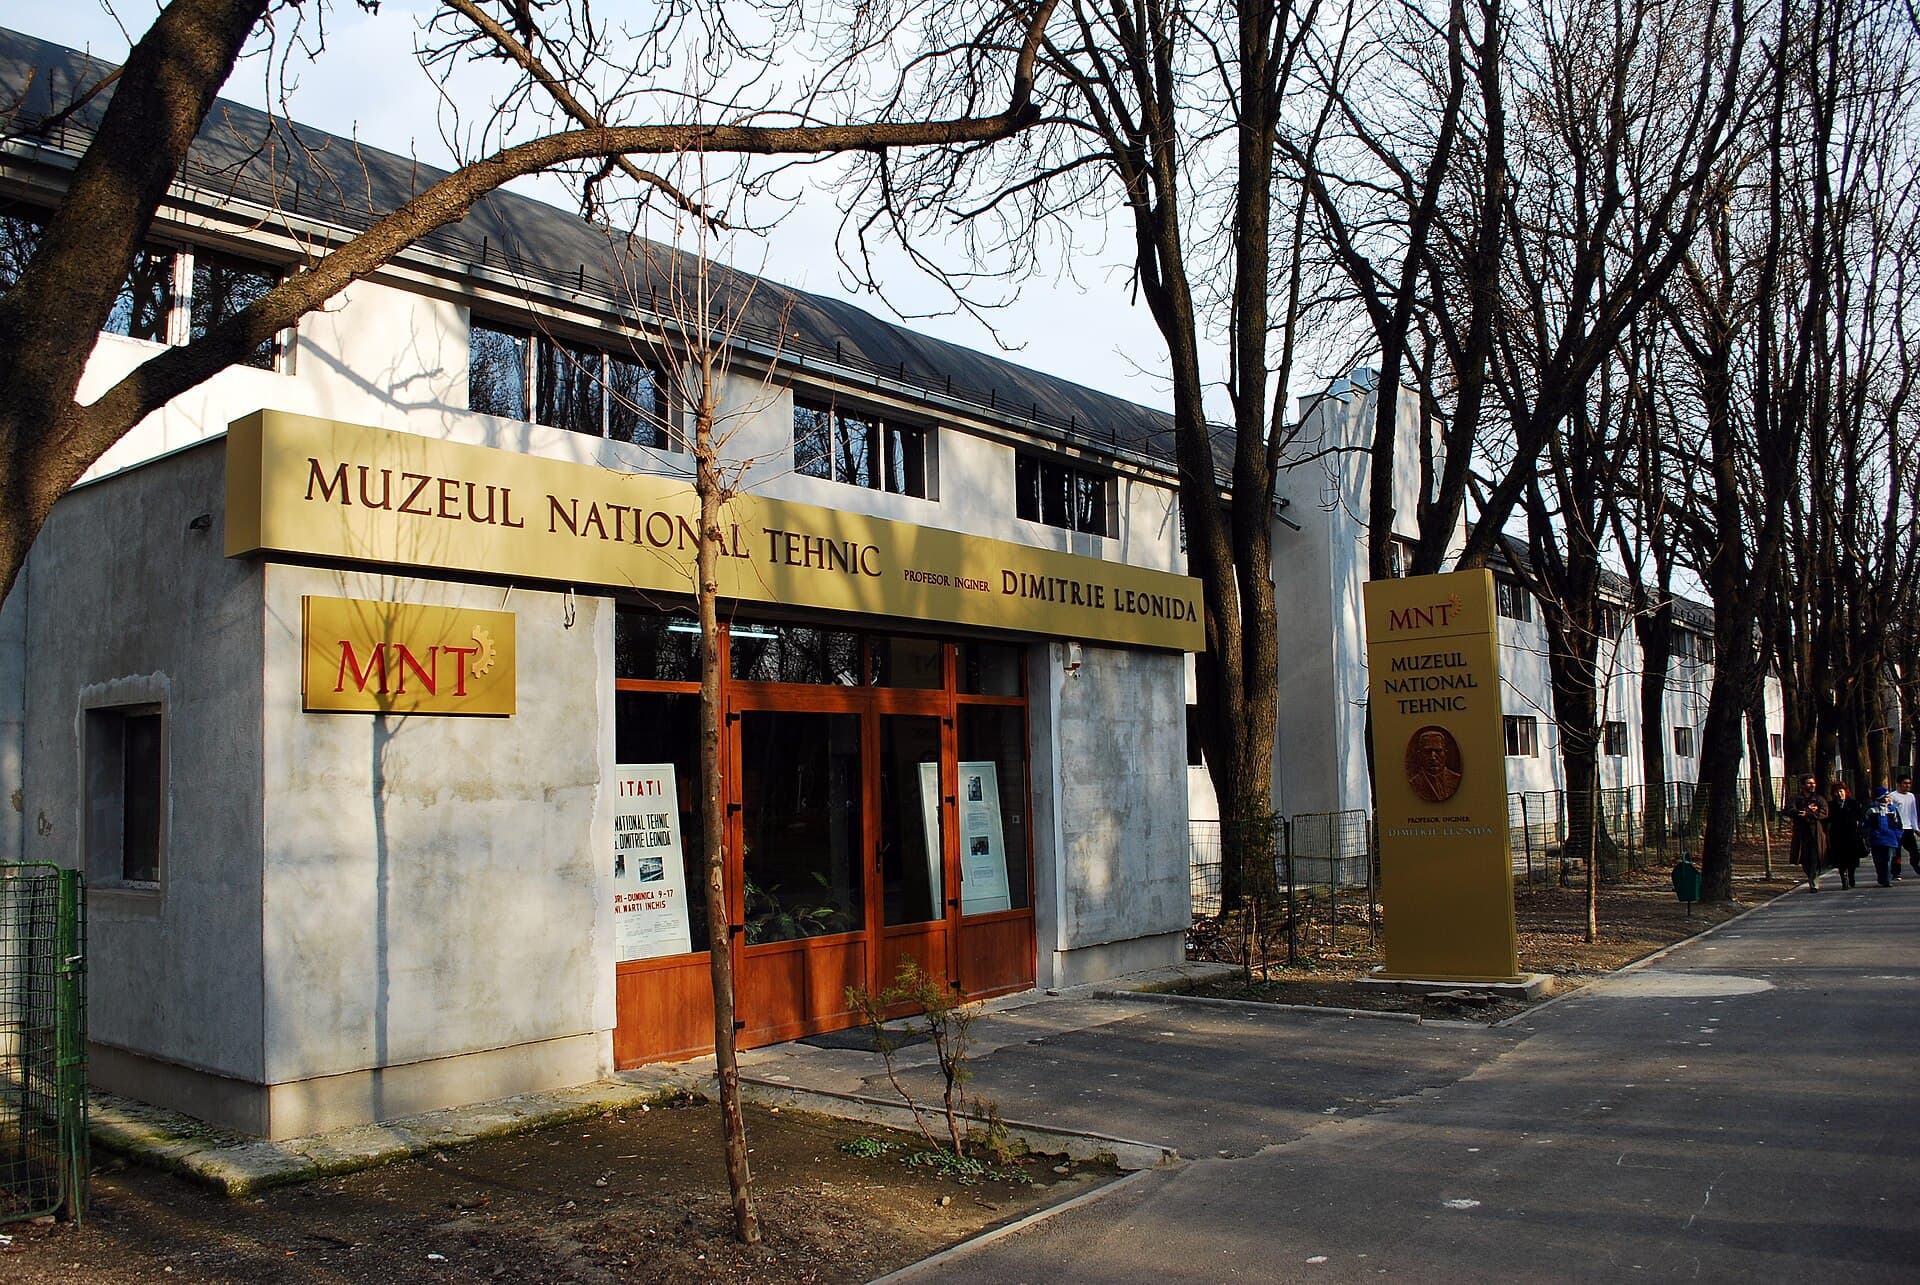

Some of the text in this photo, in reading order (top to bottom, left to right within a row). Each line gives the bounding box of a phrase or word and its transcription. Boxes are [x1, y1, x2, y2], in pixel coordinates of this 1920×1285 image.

[304, 457, 1197, 622] MUZEUL NATIONL TEHNIC PROFESOR INGINER DIMITRIE LEONIDA
[1389, 603, 1453, 631] MNT
[333, 640, 479, 697] MNT
[1391, 652, 1468, 673] MUZEUL
[1384, 673, 1478, 694] NATIONAL
[1397, 695, 1467, 714] TEHNIC
[614, 812, 670, 831] NATIONAL TEHNIC
[646, 830, 671, 847] LEONIDA
[623, 903, 642, 913] MARTI
[645, 900, 666, 911] INCHIS
